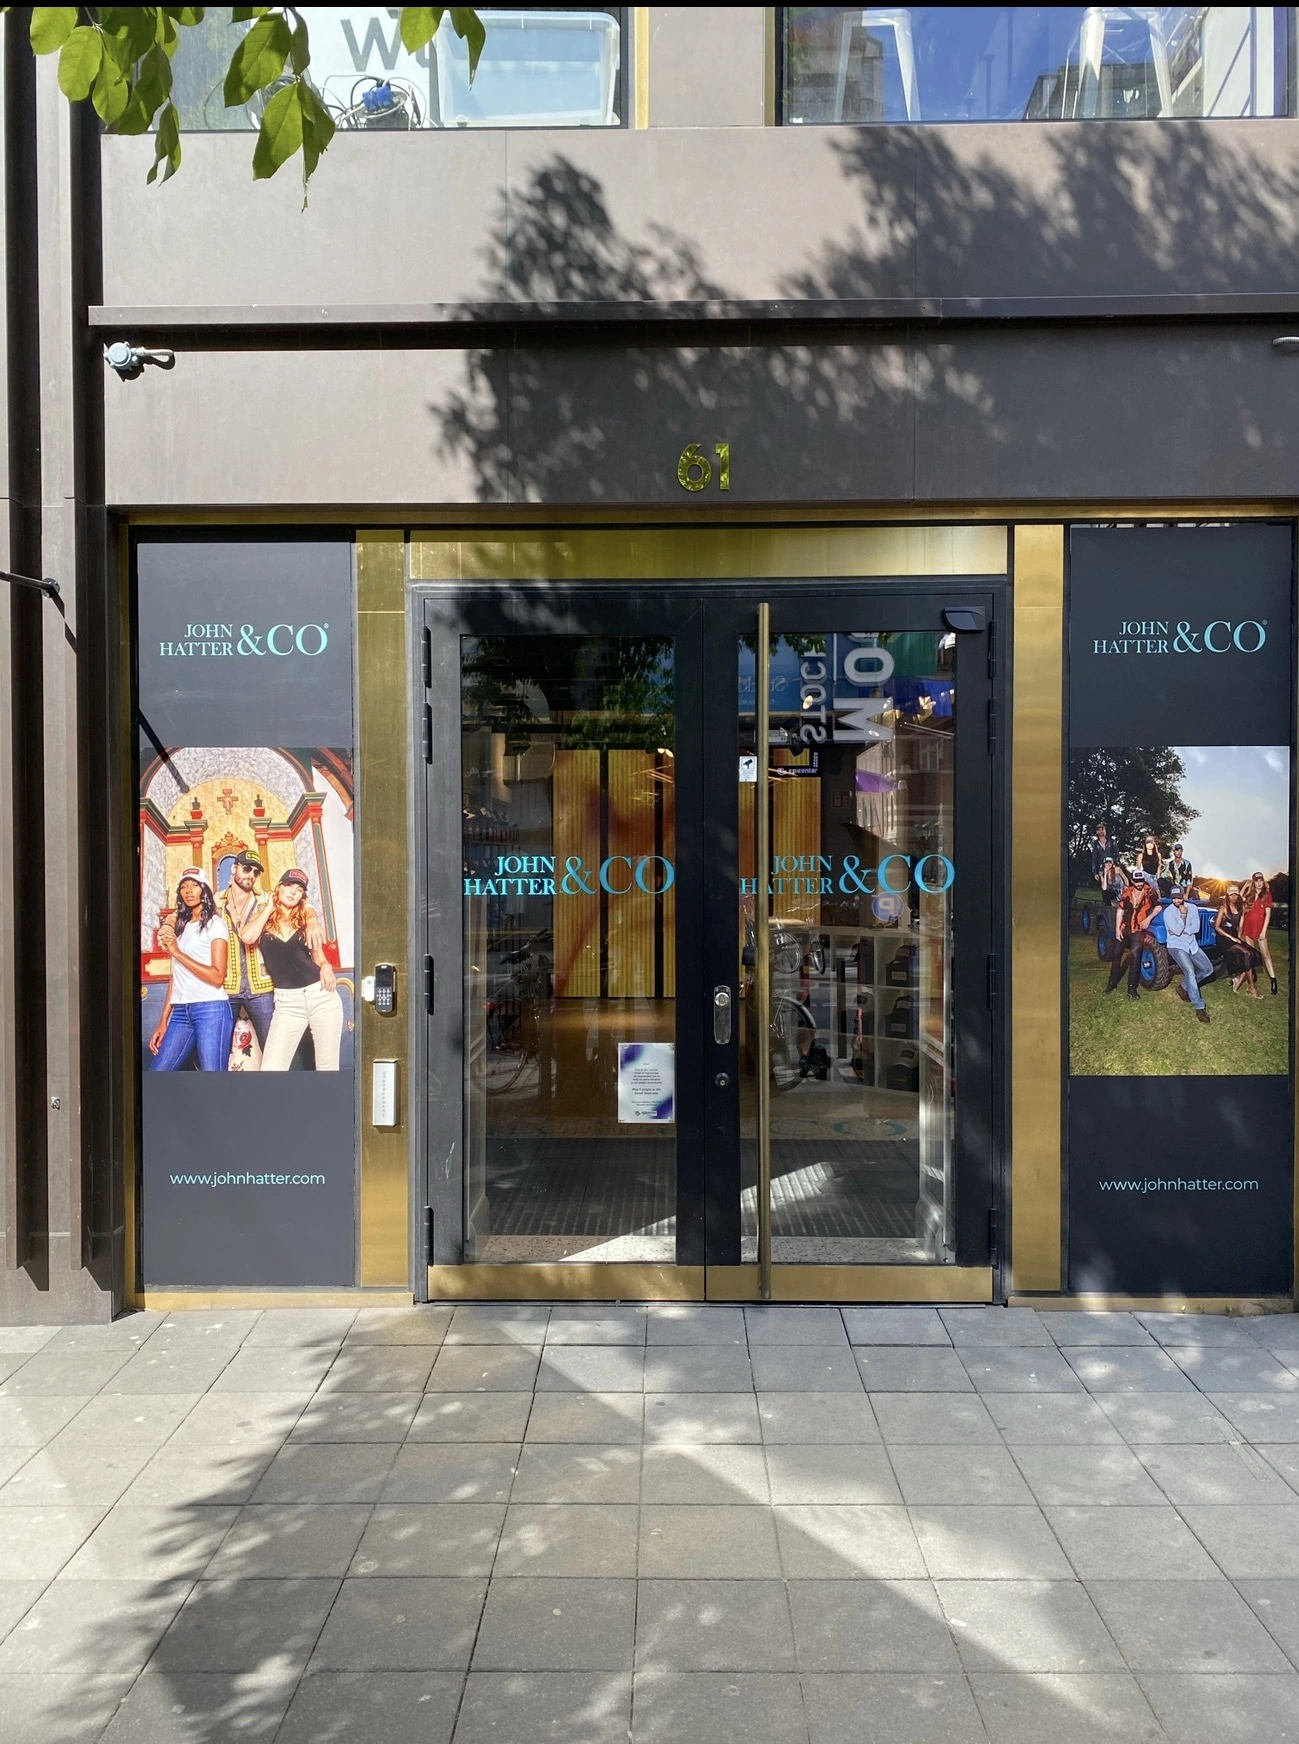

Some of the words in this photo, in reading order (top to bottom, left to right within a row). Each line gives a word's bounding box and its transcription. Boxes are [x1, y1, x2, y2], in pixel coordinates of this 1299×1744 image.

[678, 443, 730, 491] 61
[184, 623, 233, 638] JOHN
[1119, 620, 1169, 635] JOHN
[159, 642, 233, 656] HATTER
[1093, 639, 1169, 654] HATTER
[494, 856, 556, 876] JOHN
[771, 855, 833, 875] JOHN
[463, 878, 557, 896] HATTER
[169, 1171, 325, 1187] www.johnhatter.com
[1099, 1177, 1259, 1193] www.johnhatter.com
